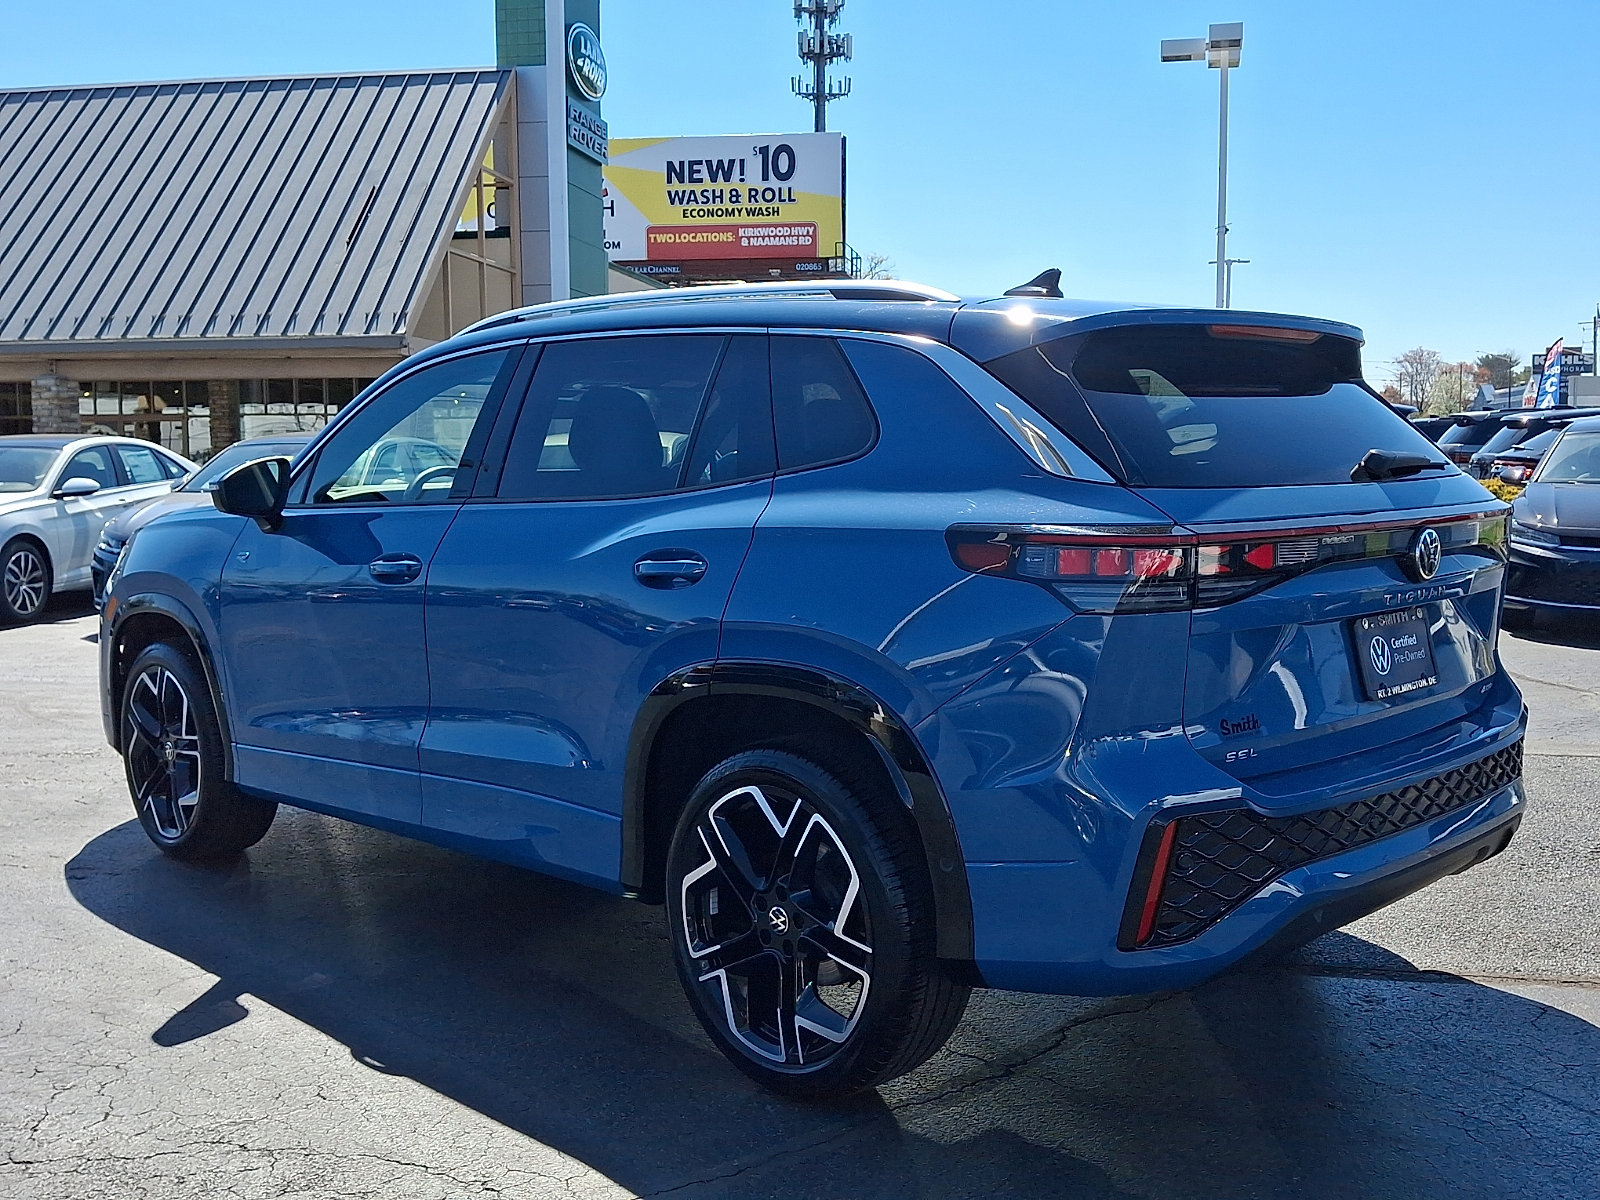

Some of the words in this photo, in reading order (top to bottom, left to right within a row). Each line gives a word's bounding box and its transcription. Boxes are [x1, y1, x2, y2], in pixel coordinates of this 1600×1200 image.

[571, 108, 606, 138] RANGE
[571, 126, 608, 159] ROVER
[666, 158, 746, 184] NEW!
[667, 188, 724, 206] WASH
[728, 188, 742, 204] &
[748, 187, 796, 204] ROLL
[682, 207, 743, 219] ECONOMY
[744, 206, 780, 217] WASH
[649, 233, 675, 243] TWO
[675, 232, 736, 242] LOCATIONS:
[739, 227, 791, 237] KIRKWOOD
[791, 226, 814, 235] HWY
[741, 237, 749, 247] &
[749, 237, 798, 246] NAAMANS
[798, 236, 813, 245] RD
[648, 265, 681, 274] CHANNEL
[1533, 355, 1594, 365] KHL'S
[1384, 586, 1446, 605] TIGUAN
[1377, 611, 1409, 627] SMITH
[1391, 633, 1417, 649] Certified
[1393, 647, 1426, 664] Pre-Owned
[1427, 675, 1437, 686] DE
[1220, 713, 1260, 735] Smith
[1225, 748, 1258, 763] SEL
